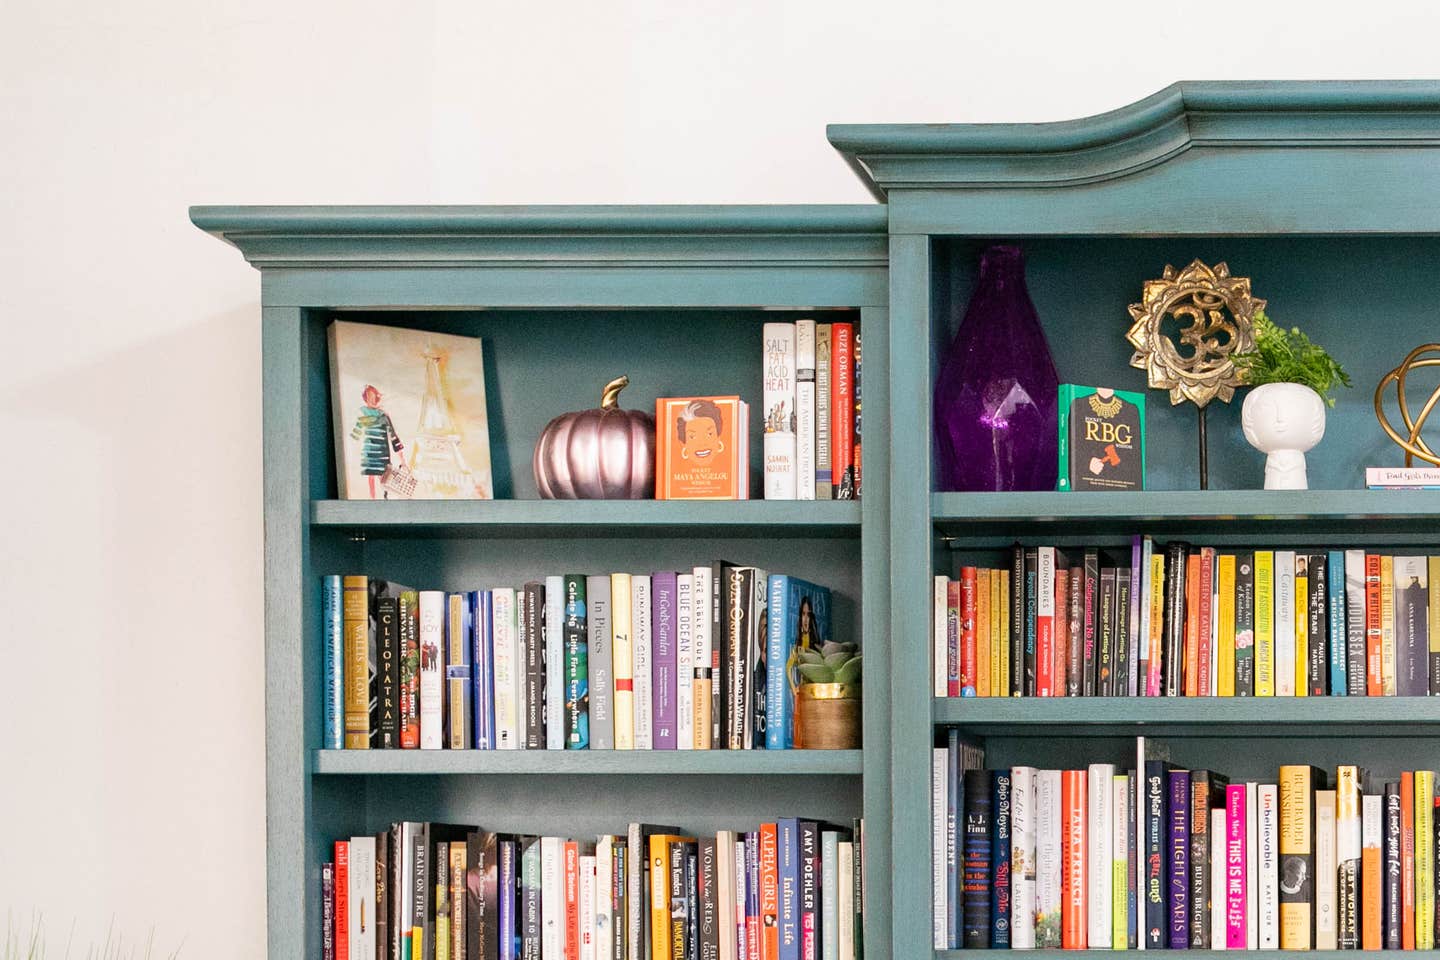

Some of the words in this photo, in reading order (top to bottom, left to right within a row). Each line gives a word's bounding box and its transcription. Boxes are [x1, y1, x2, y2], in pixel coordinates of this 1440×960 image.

[766, 339, 789, 352] SALT
[839, 329, 848, 354] SUZE
[767, 367, 788, 377] ACID
[768, 353, 785, 364] FAT
[765, 379, 789, 391] HEAT
[839, 356, 848, 395] ORMAN
[1084, 421, 1133, 444] RBG
[1386, 471, 1403, 480] Bad
[1404, 471, 1421, 480] Girls
[569, 582, 578, 610] Celeste
[680, 584, 690, 611] BLUE
[730, 573, 744, 604] SUZE
[771, 579, 782, 615] MARIE
[1026, 571, 1035, 598] Beyond
[568, 612, 577, 627] Ng
[730, 607, 743, 657] ORMAN
[1026, 600, 1035, 655] Codependency
[570, 634, 578, 655] Little
[680, 617, 690, 652] OCEAN
[771, 617, 782, 660] FORLEO
[382, 615, 392, 719] CLEOPATRA
[570, 657, 578, 677] Fires
[595, 669, 606, 691] Sally
[568, 679, 579, 729] Everywhere
[596, 695, 606, 720] Field
[1294, 774, 1303, 804] RUTH
[1281, 780, 1290, 838] GINSBURG
[968, 824, 986, 834] Finn
[1072, 808, 1082, 845] TANA
[1294, 807, 1304, 845] BADER
[763, 831, 774, 873] ALPHA
[804, 830, 813, 854] AMY
[416, 845, 424, 877] BRAIN
[567, 849, 576, 871] Gloria
[416, 879, 424, 892] ON
[567, 873, 576, 902] Steinem
[763, 875, 774, 910] GIRLS
[804, 857, 813, 908] POEHLER
[1072, 852, 1082, 906] FRENCH
[1194, 866, 1202, 893] BURN
[416, 895, 424, 918] FIRE
[783, 877, 793, 919] Infinite
[804, 913, 813, 928] YES
[1194, 897, 1202, 933] BRIGHT
[783, 923, 793, 945] Life
